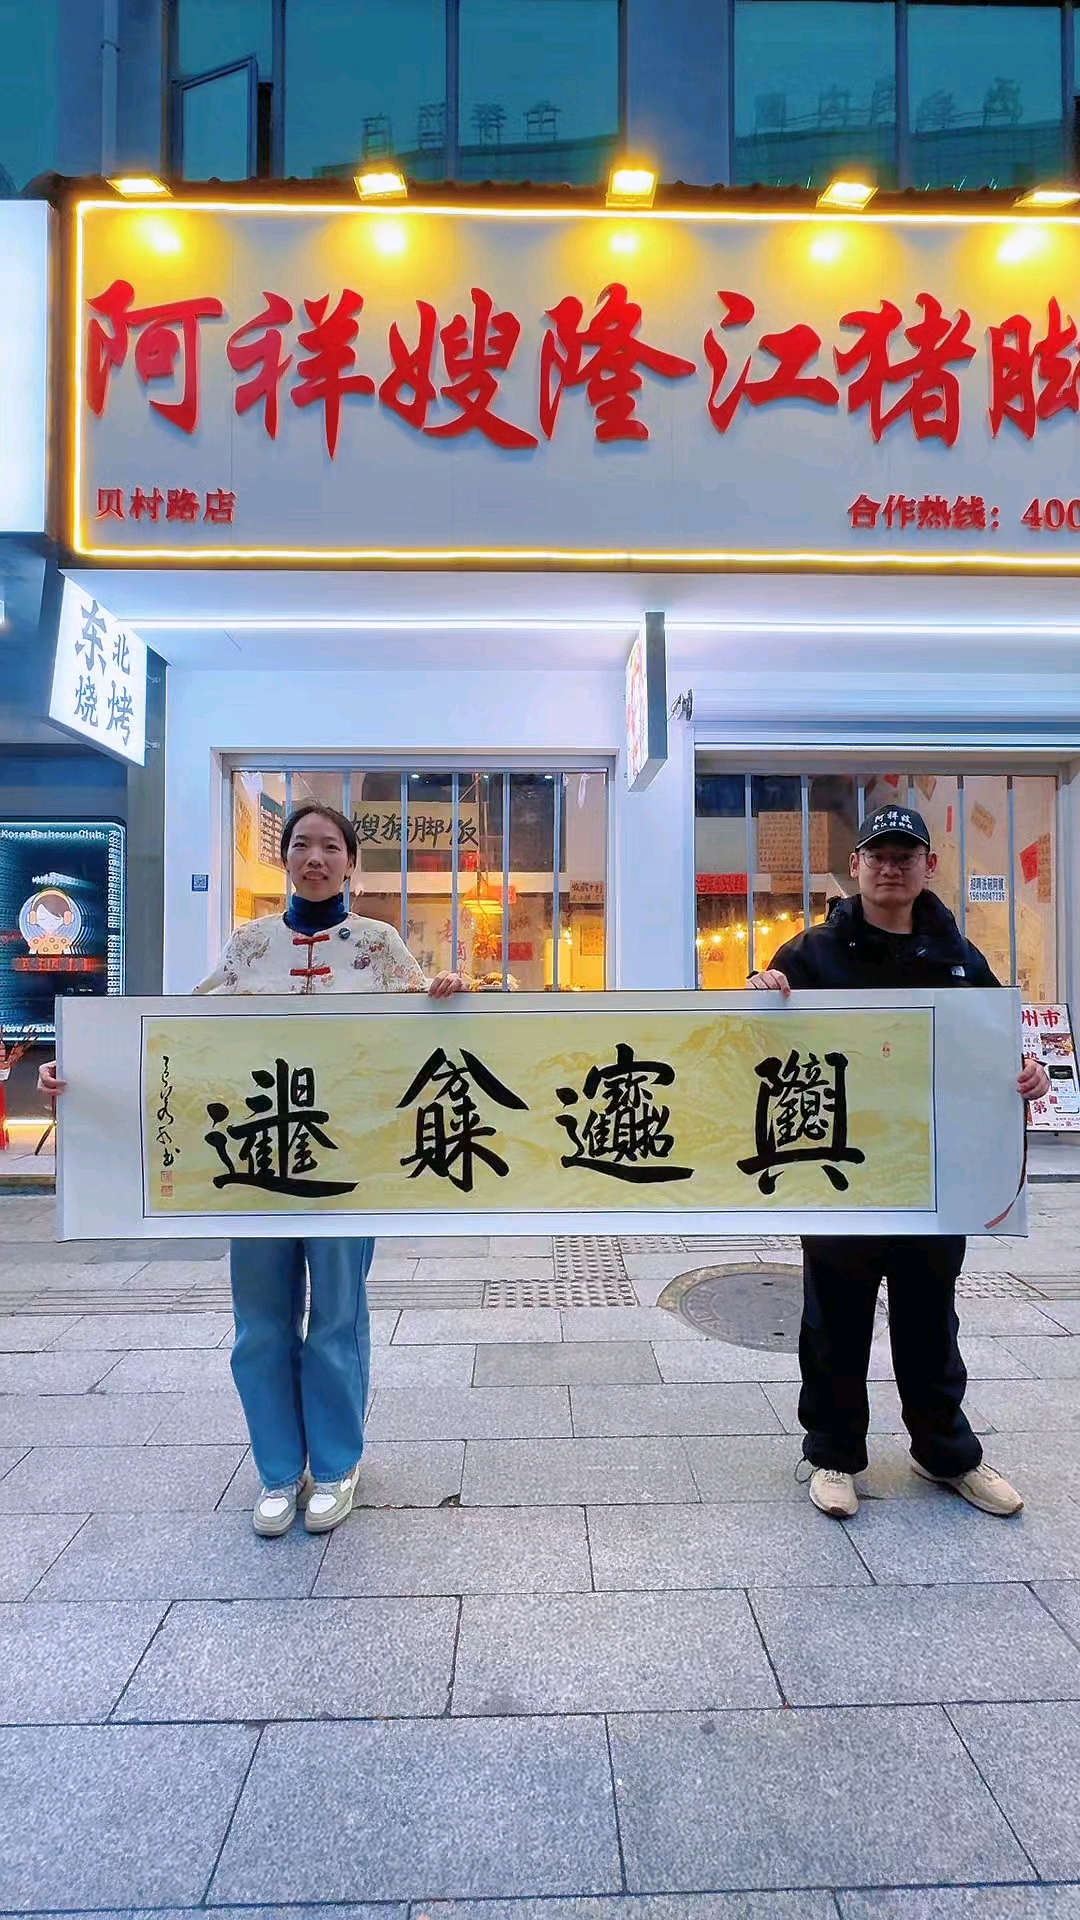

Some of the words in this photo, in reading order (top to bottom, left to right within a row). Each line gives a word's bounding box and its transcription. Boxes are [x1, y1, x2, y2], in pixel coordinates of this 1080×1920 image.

[96, 487, 236, 524] 贝村路店
[75, 600, 131, 676] 东北
[74, 675, 134, 746] 烧烤
